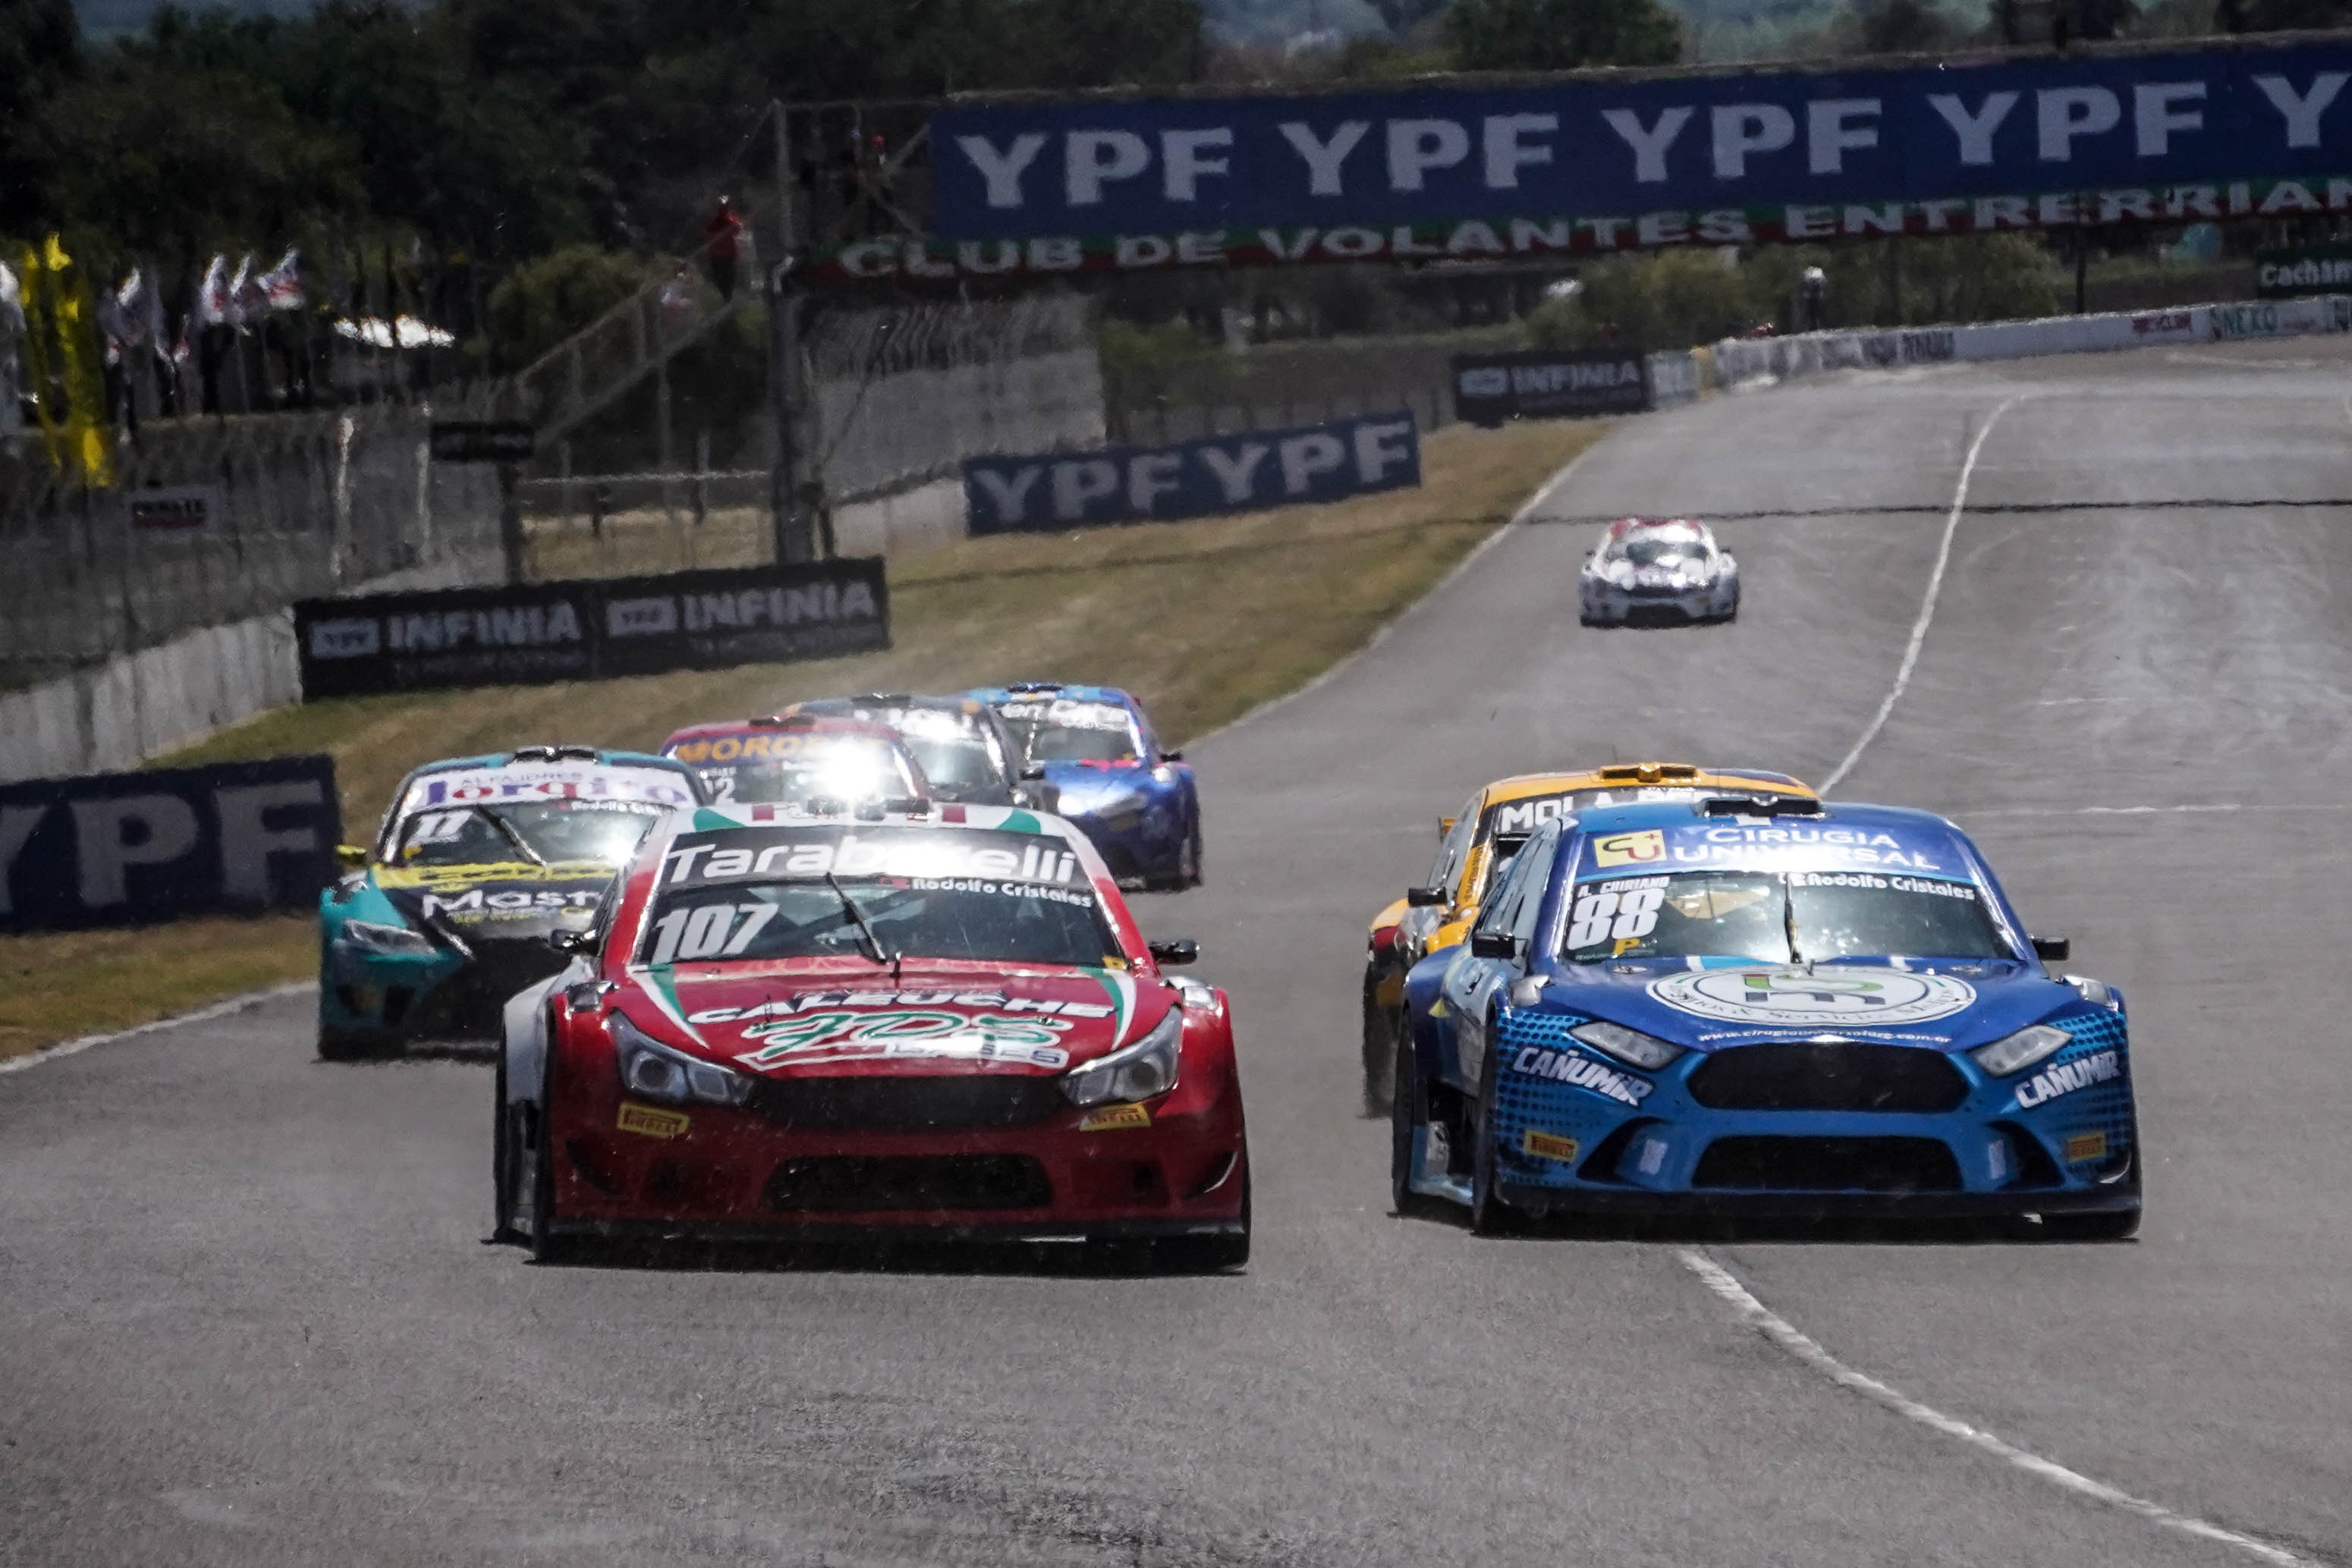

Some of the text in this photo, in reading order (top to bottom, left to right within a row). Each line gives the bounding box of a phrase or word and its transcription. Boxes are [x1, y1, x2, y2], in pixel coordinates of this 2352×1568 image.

[955, 127, 1235, 209] YPF
[1279, 114, 1560, 196] YPF
[1602, 99, 1882, 183] YPF
[1929, 81, 2208, 165] YPF
[839, 237, 1083, 278] CLUB
[1115, 231, 1228, 269] DE
[1256, 210, 1750, 264] VOLANTES
[972, 422, 1413, 523] YPF YPF
[388, 601, 581, 651] INFINIA
[683, 581, 876, 632] INFINIA
[668, 835, 1076, 885] Tarabelli
[1673, 844, 1941, 870] UNIVRSAL
[1706, 827, 1900, 849] CIRUGIA
[912, 878, 1093, 907] Rodolfo Cristales
[1809, 874, 1976, 901] Rodolfo Cristales
[652, 902, 780, 965] 107
[1567, 888, 1665, 950] 88
[687, 991, 1115, 1024] CALEUCHE
[624, 1110, 681, 1135] PIRELLI
